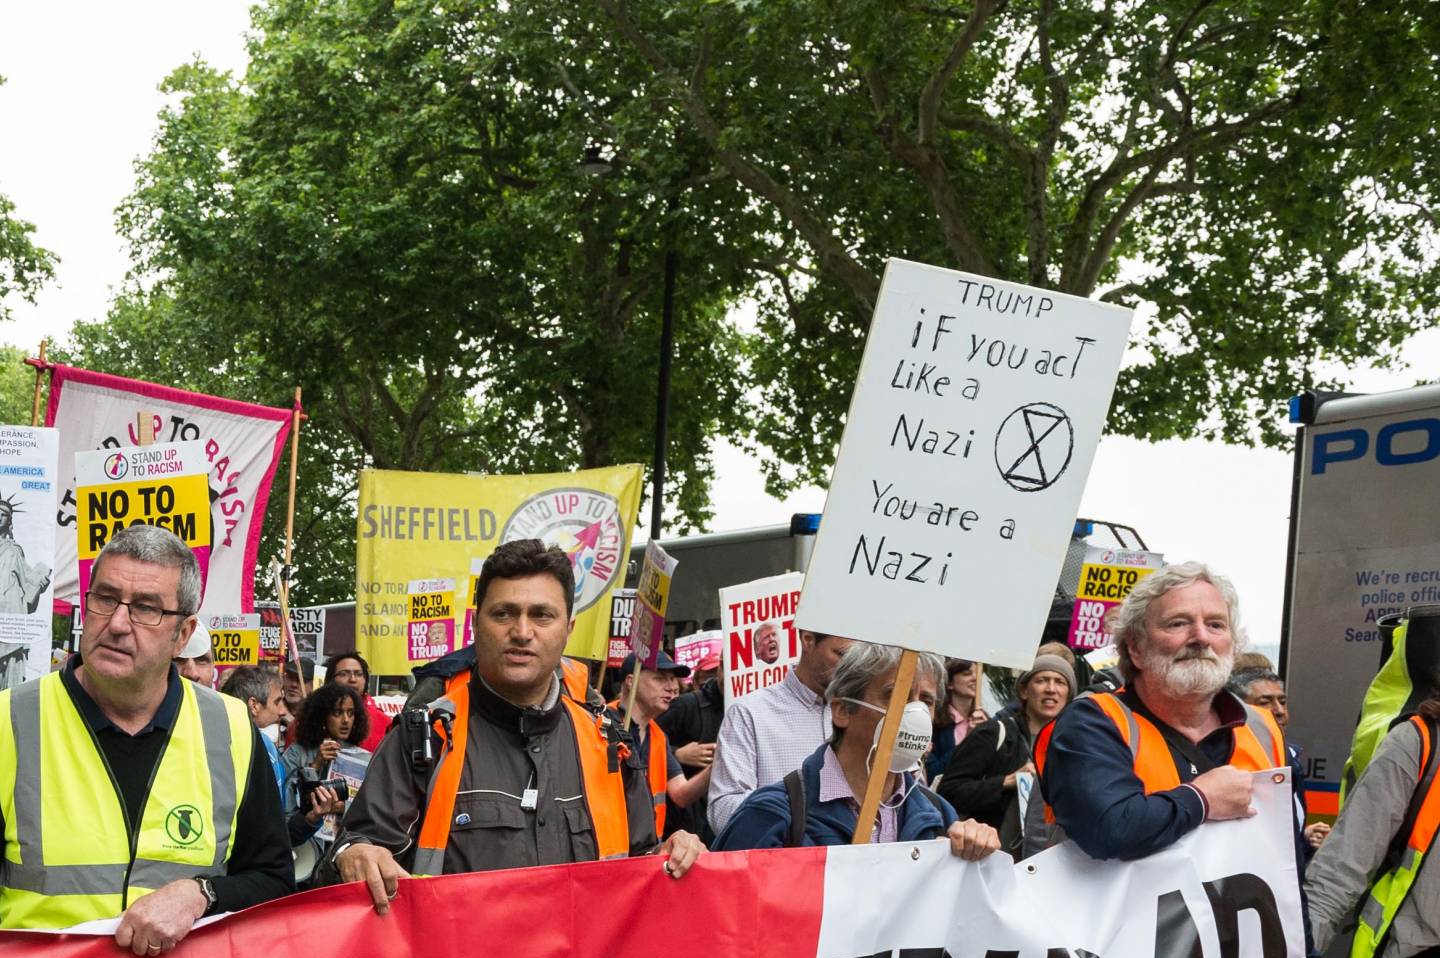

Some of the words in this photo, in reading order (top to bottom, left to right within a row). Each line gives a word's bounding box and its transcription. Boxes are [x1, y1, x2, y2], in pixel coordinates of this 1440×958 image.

[958, 279, 1055, 319] TRUMP
[966, 333, 1029, 370] you
[960, 376, 981, 400] a
[170, 415, 200, 443] TO
[889, 413, 975, 459] Nazi
[0, 448, 22, 456] HOPE
[1311, 417, 1440, 476] PO
[131, 451, 162, 464] STAND
[164, 449, 177, 461] UP
[4, 466, 44, 477] AMERICA
[132, 465, 145, 477] TO
[148, 461, 183, 475] RACISM
[21, 481, 51, 491] GREAT
[88, 489, 130, 521] NO
[137, 485, 175, 516] TO
[871, 478, 918, 521] You
[926, 500, 980, 533] are
[998, 517, 1016, 540] a
[362, 504, 497, 542] SHEFFIELD
[506, 500, 553, 540] TAND
[554, 494, 580, 515] UP
[585, 496, 608, 519] TO
[848, 533, 954, 587] Nazi
[1086, 567, 1112, 582] NO
[1117, 570, 1138, 584] TO
[1405, 570, 1440, 584] recru
[361, 582, 382, 594] NO
[384, 582, 396, 594] TO
[1084, 583, 1133, 599] RACIS
[412, 596, 427, 607] NO
[431, 594, 443, 606] TO
[1361, 588, 1405, 608] police
[1411, 586, 1440, 602] offi
[289, 608, 322, 621] ASTY
[412, 605, 450, 619] RACISM
[613, 598, 635, 618] DU
[729, 591, 801, 627] TRUMP
[1079, 601, 1105, 616] NO
[292, 621, 323, 633] ARDS
[361, 624, 390, 637] AND
[411, 623, 428, 636] NO
[612, 617, 632, 636] TR
[1077, 616, 1101, 632] TO
[211, 634, 220, 647] O
[223, 633, 241, 647] TO
[411, 635, 427, 648] TO
[1074, 631, 1112, 648] TRU
[213, 648, 251, 662] ACISM
[411, 644, 449, 659] TRUMP
